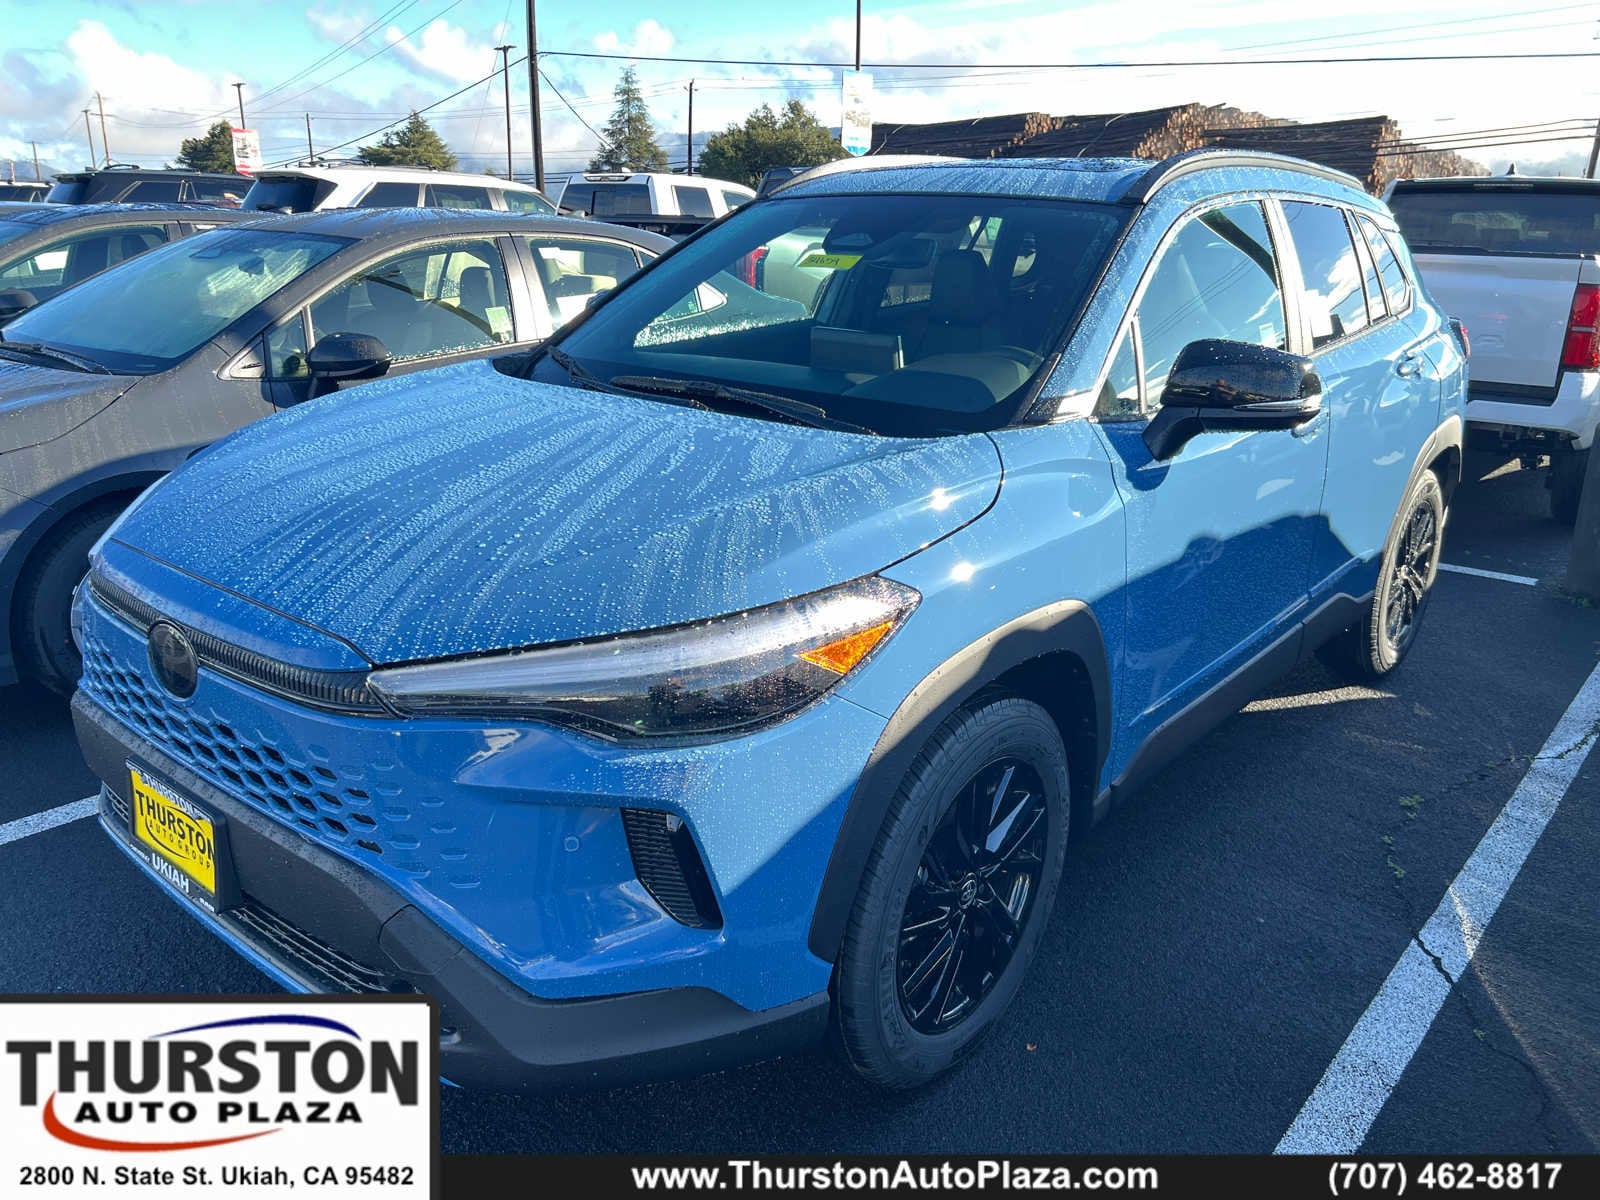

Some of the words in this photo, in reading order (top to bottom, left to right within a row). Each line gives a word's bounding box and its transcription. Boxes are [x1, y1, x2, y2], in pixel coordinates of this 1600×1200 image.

[135, 790, 214, 862] THURSTON
[149, 822, 175, 844] AUTO
[177, 841, 211, 870] GROUP
[151, 852, 191, 893] UKIAH
